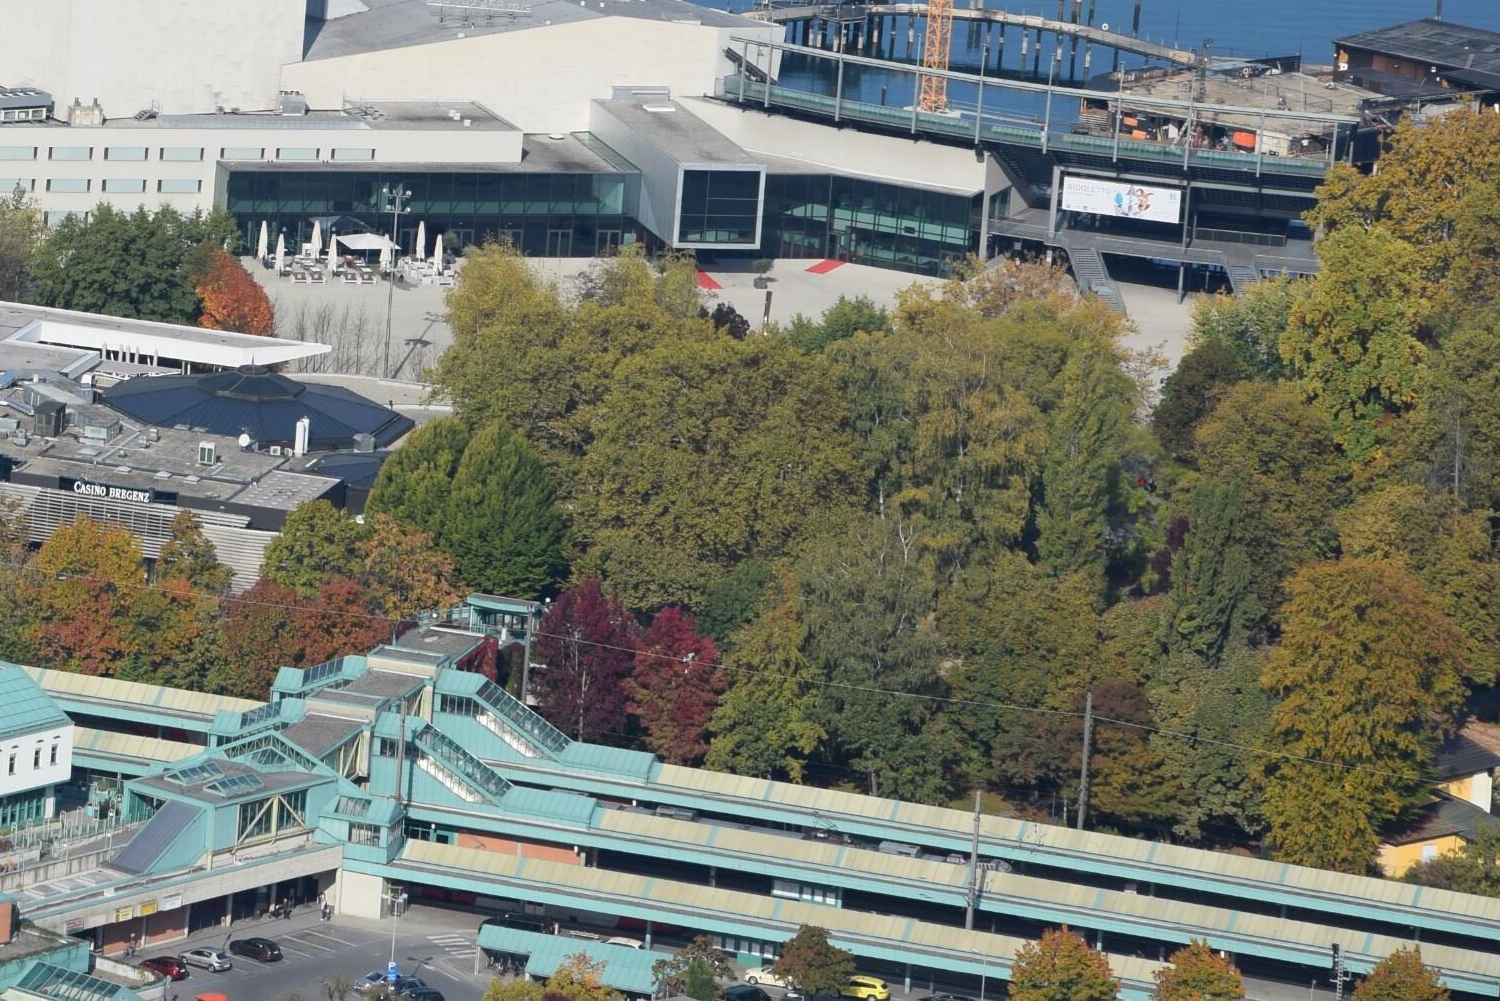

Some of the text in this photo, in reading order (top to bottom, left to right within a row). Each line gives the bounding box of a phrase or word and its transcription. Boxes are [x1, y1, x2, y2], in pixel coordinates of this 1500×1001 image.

[73, 481, 150, 503] CASINO BREGENZ
[388, 961, 396, 971] P
